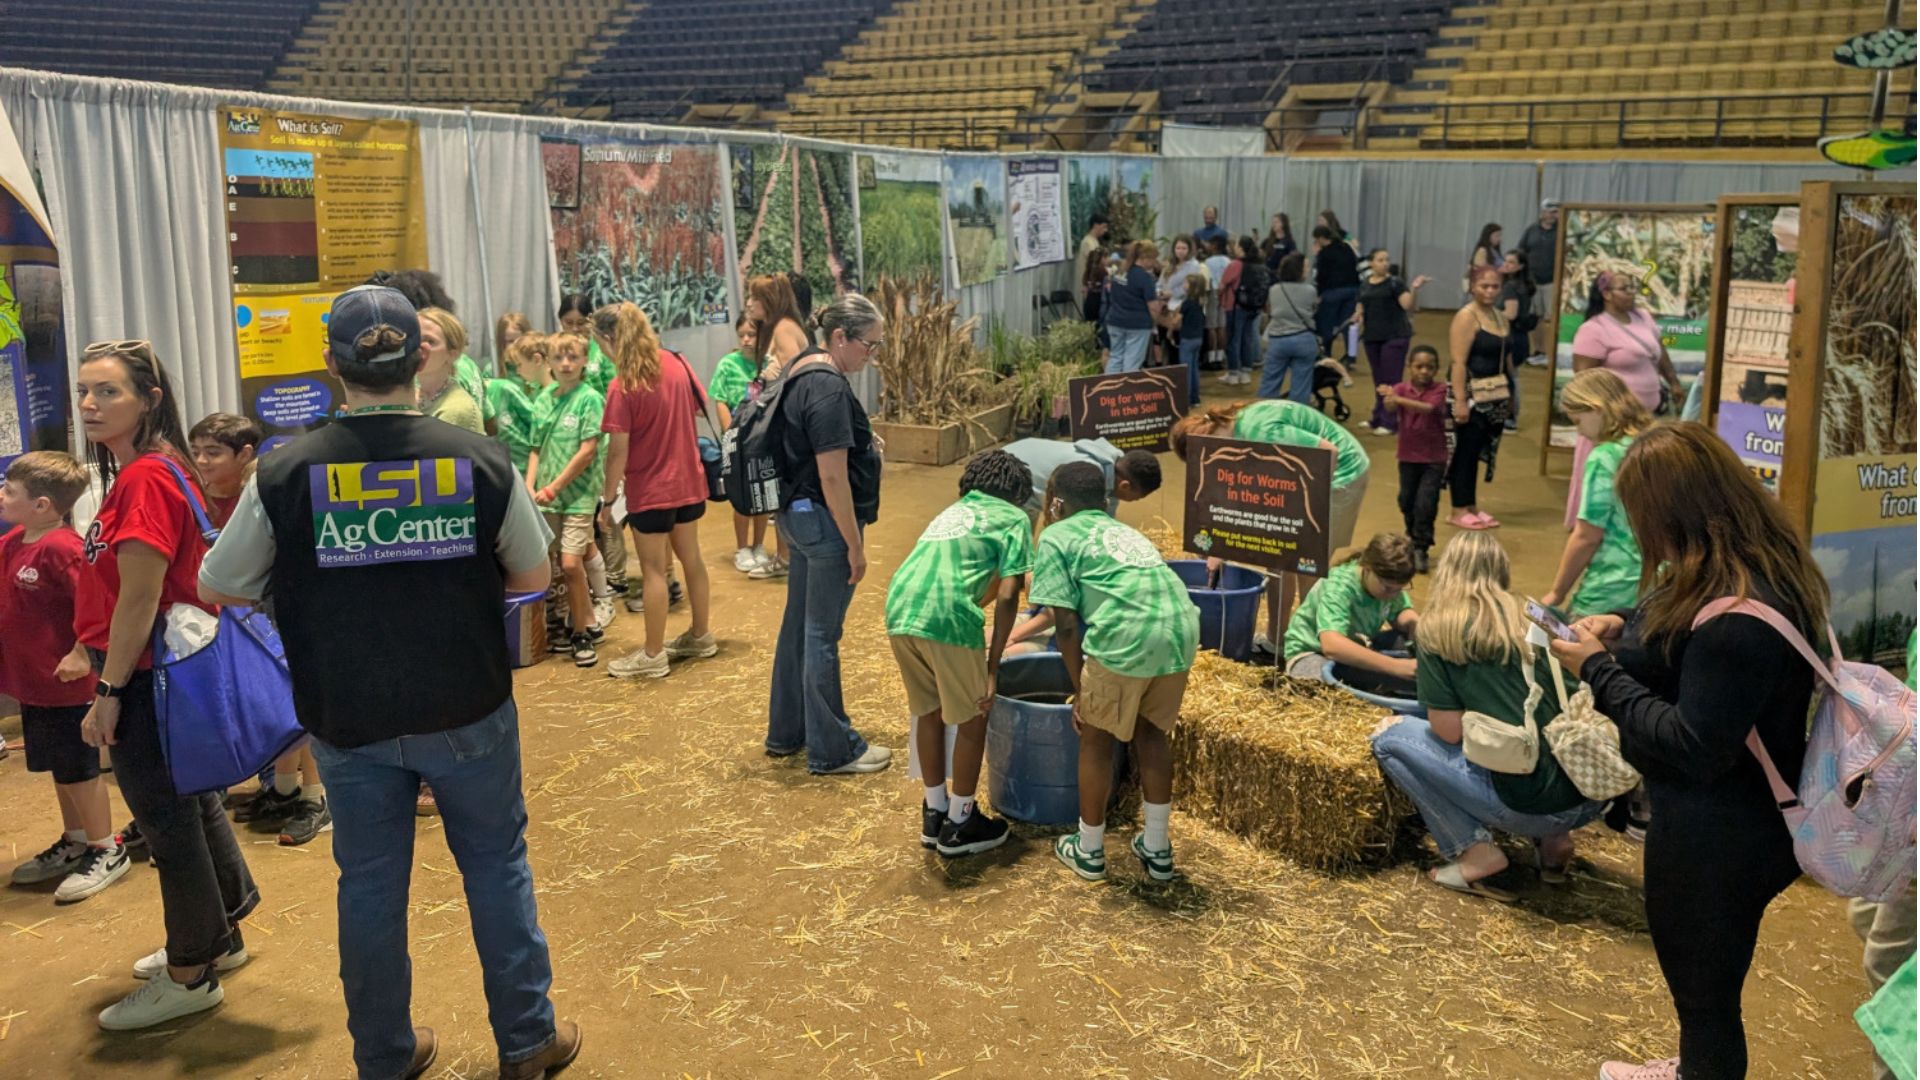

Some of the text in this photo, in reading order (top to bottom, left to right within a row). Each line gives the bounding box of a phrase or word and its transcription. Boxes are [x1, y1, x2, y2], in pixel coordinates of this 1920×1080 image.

[278, 119, 344, 135] What is Soil?
[270, 135, 285, 144] Soil
[228, 186, 238, 195] A
[229, 203, 236, 211] E
[230, 233, 238, 241] B
[1667, 324, 1703, 335] make
[1100, 391, 1165, 407] Dig for Worms
[1110, 403, 1158, 417] in the Soil
[309, 457, 474, 510] LSU
[1217, 468, 1297, 492] Dig for Worms
[1857, 463, 1907, 490] What
[1227, 487, 1284, 508] in the Soil
[1209, 505, 1304, 527] Earthworms are good for the soil
[1212, 514, 1223, 523] and
[1224, 516, 1233, 524] the
[1234, 518, 1252, 527] plants
[1253, 520, 1266, 529] that
[1267, 523, 1282, 532] grow
[1283, 524, 1290, 532] in
[1212, 528, 1296, 550] Please put worms back in soil
[1225, 538, 1282, 555] for the next visitor.
[320, 543, 474, 563] Research Extension Teaching
